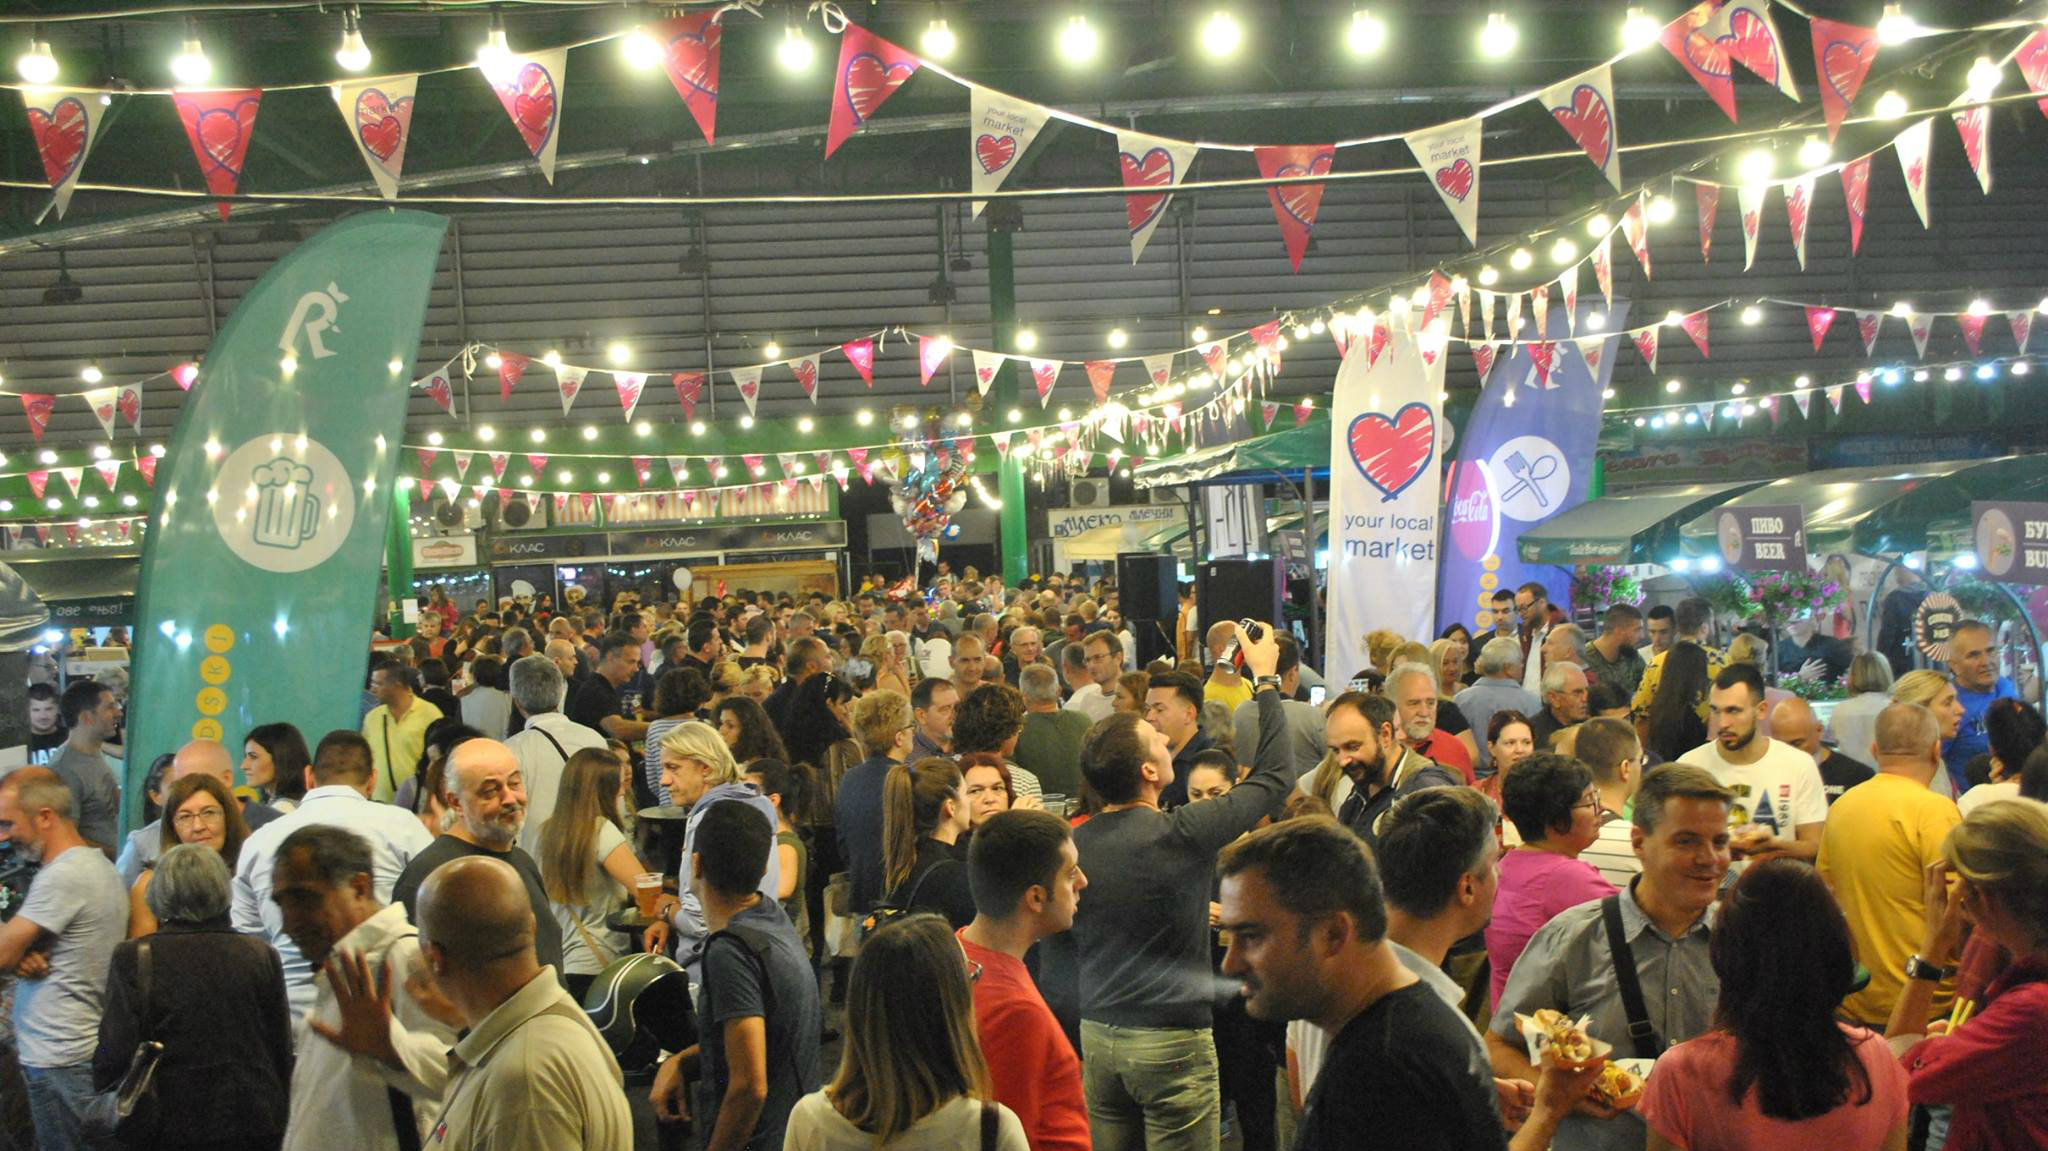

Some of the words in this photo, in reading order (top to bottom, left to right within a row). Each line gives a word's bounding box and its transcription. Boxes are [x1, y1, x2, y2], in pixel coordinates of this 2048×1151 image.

[983, 117, 1025, 137] market
[1431, 145, 1470, 162] market
[1345, 515, 1384, 530] your
[1391, 514, 1433, 531] local
[1751, 517, 1784, 534] ПИВО
[2024, 520, 2048, 539] БУ
[1345, 537, 1434, 560] market
[1754, 542, 1786, 560] BEER
[2024, 549, 2048, 569] BU
